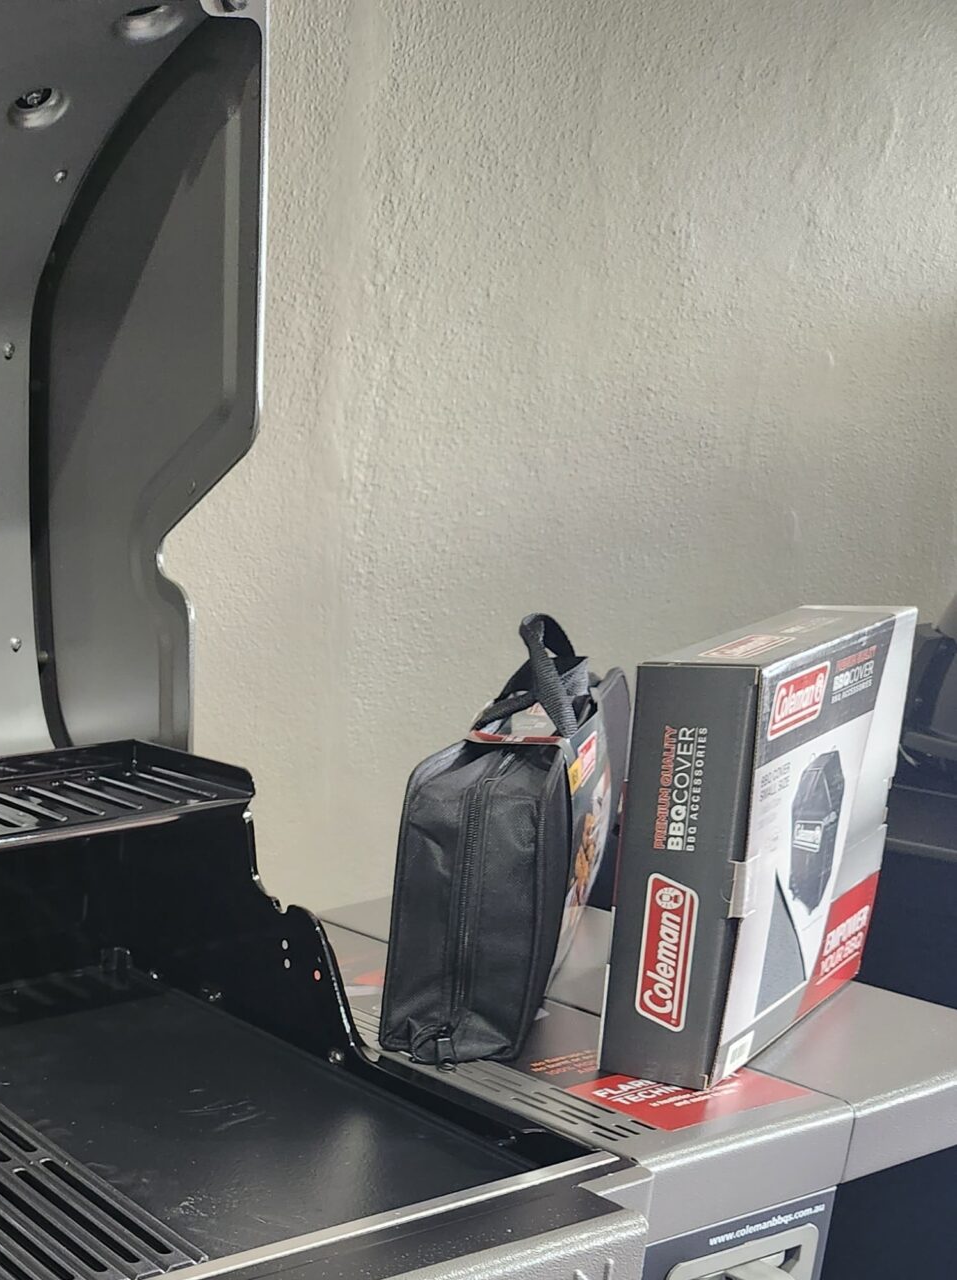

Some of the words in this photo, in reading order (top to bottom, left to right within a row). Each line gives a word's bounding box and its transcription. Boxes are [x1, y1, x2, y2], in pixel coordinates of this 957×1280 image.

[774, 680, 817, 723] Coleman
[660, 725, 677, 787] QUALITY
[690, 727, 708, 820] ACCESSORIES
[654, 787, 672, 850] PREMIUM
[686, 826, 697, 852] BBQ
[643, 911, 681, 1014] Coleman
[612, 1085, 682, 1105] TECHN
[709, 1203, 825, 1246] www.colemanbbqs.com.au
